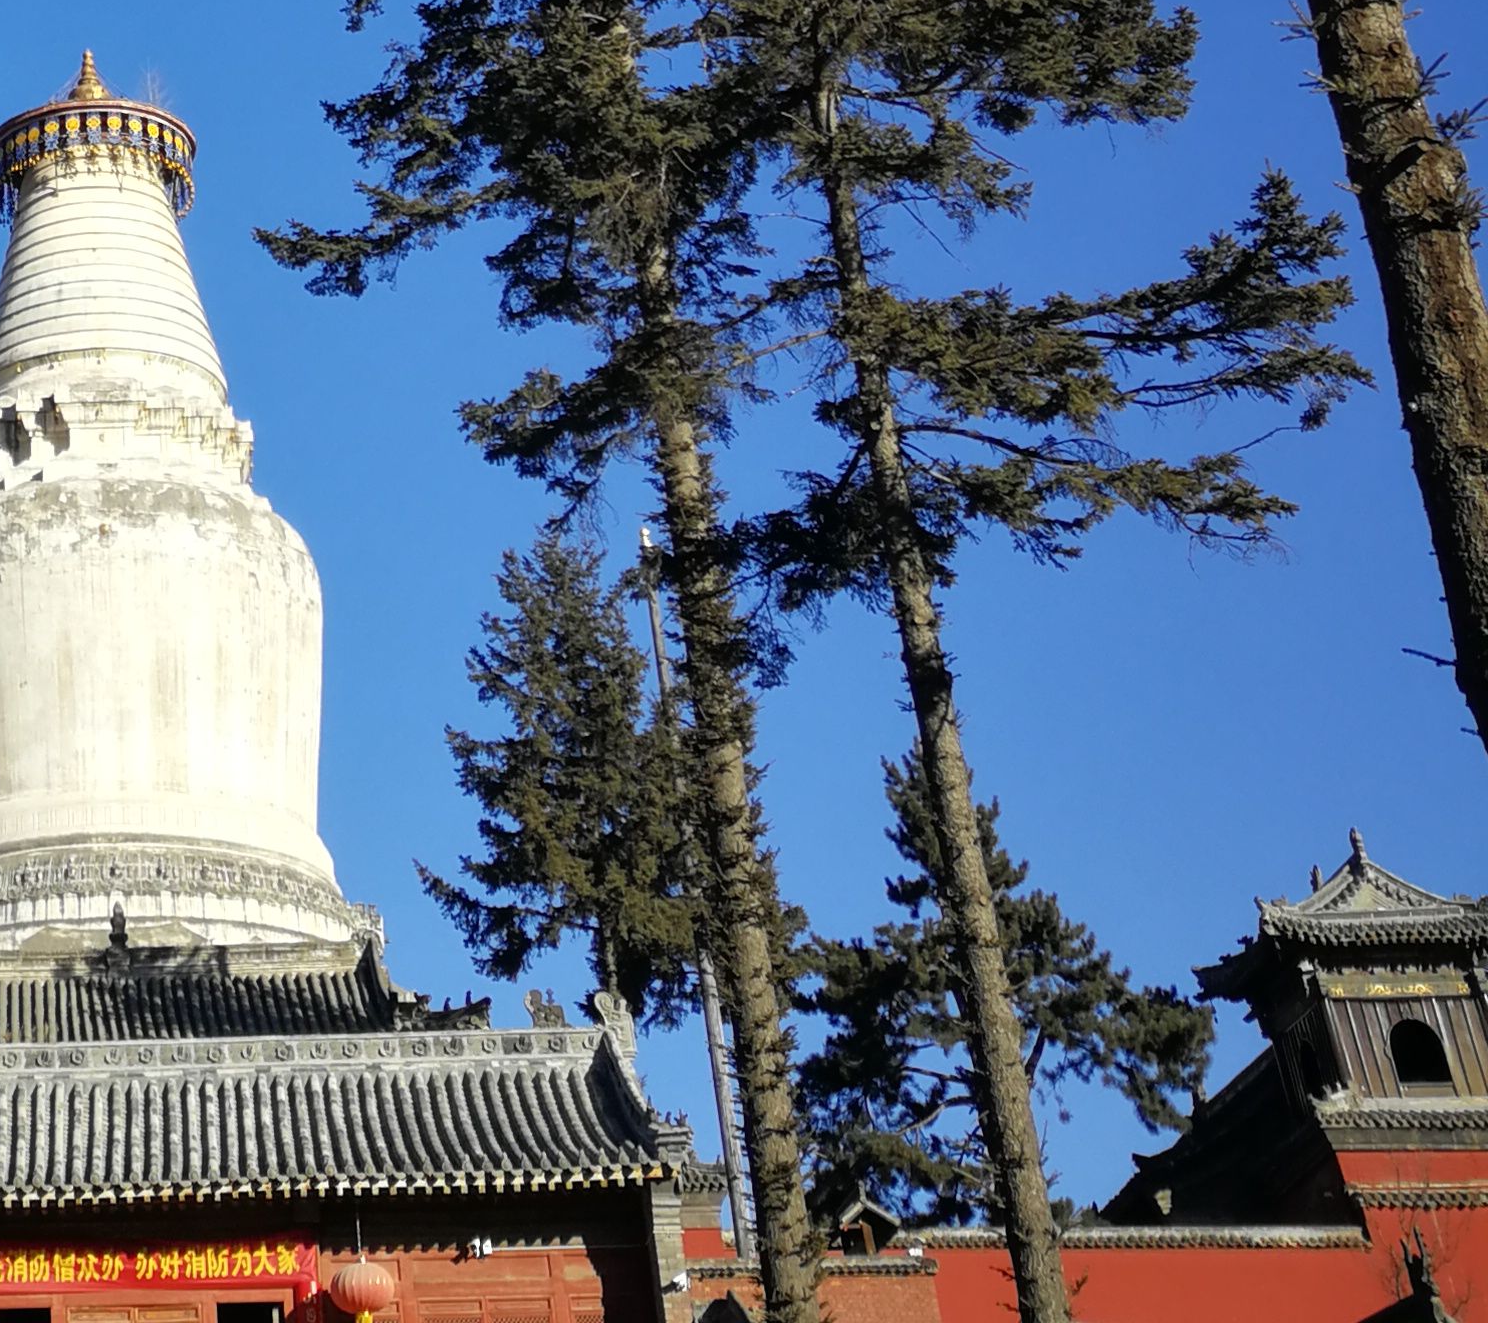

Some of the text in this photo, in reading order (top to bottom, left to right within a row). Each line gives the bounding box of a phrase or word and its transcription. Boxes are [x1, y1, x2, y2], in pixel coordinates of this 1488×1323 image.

[134, 1241, 301, 1281] 办好消防为大家
